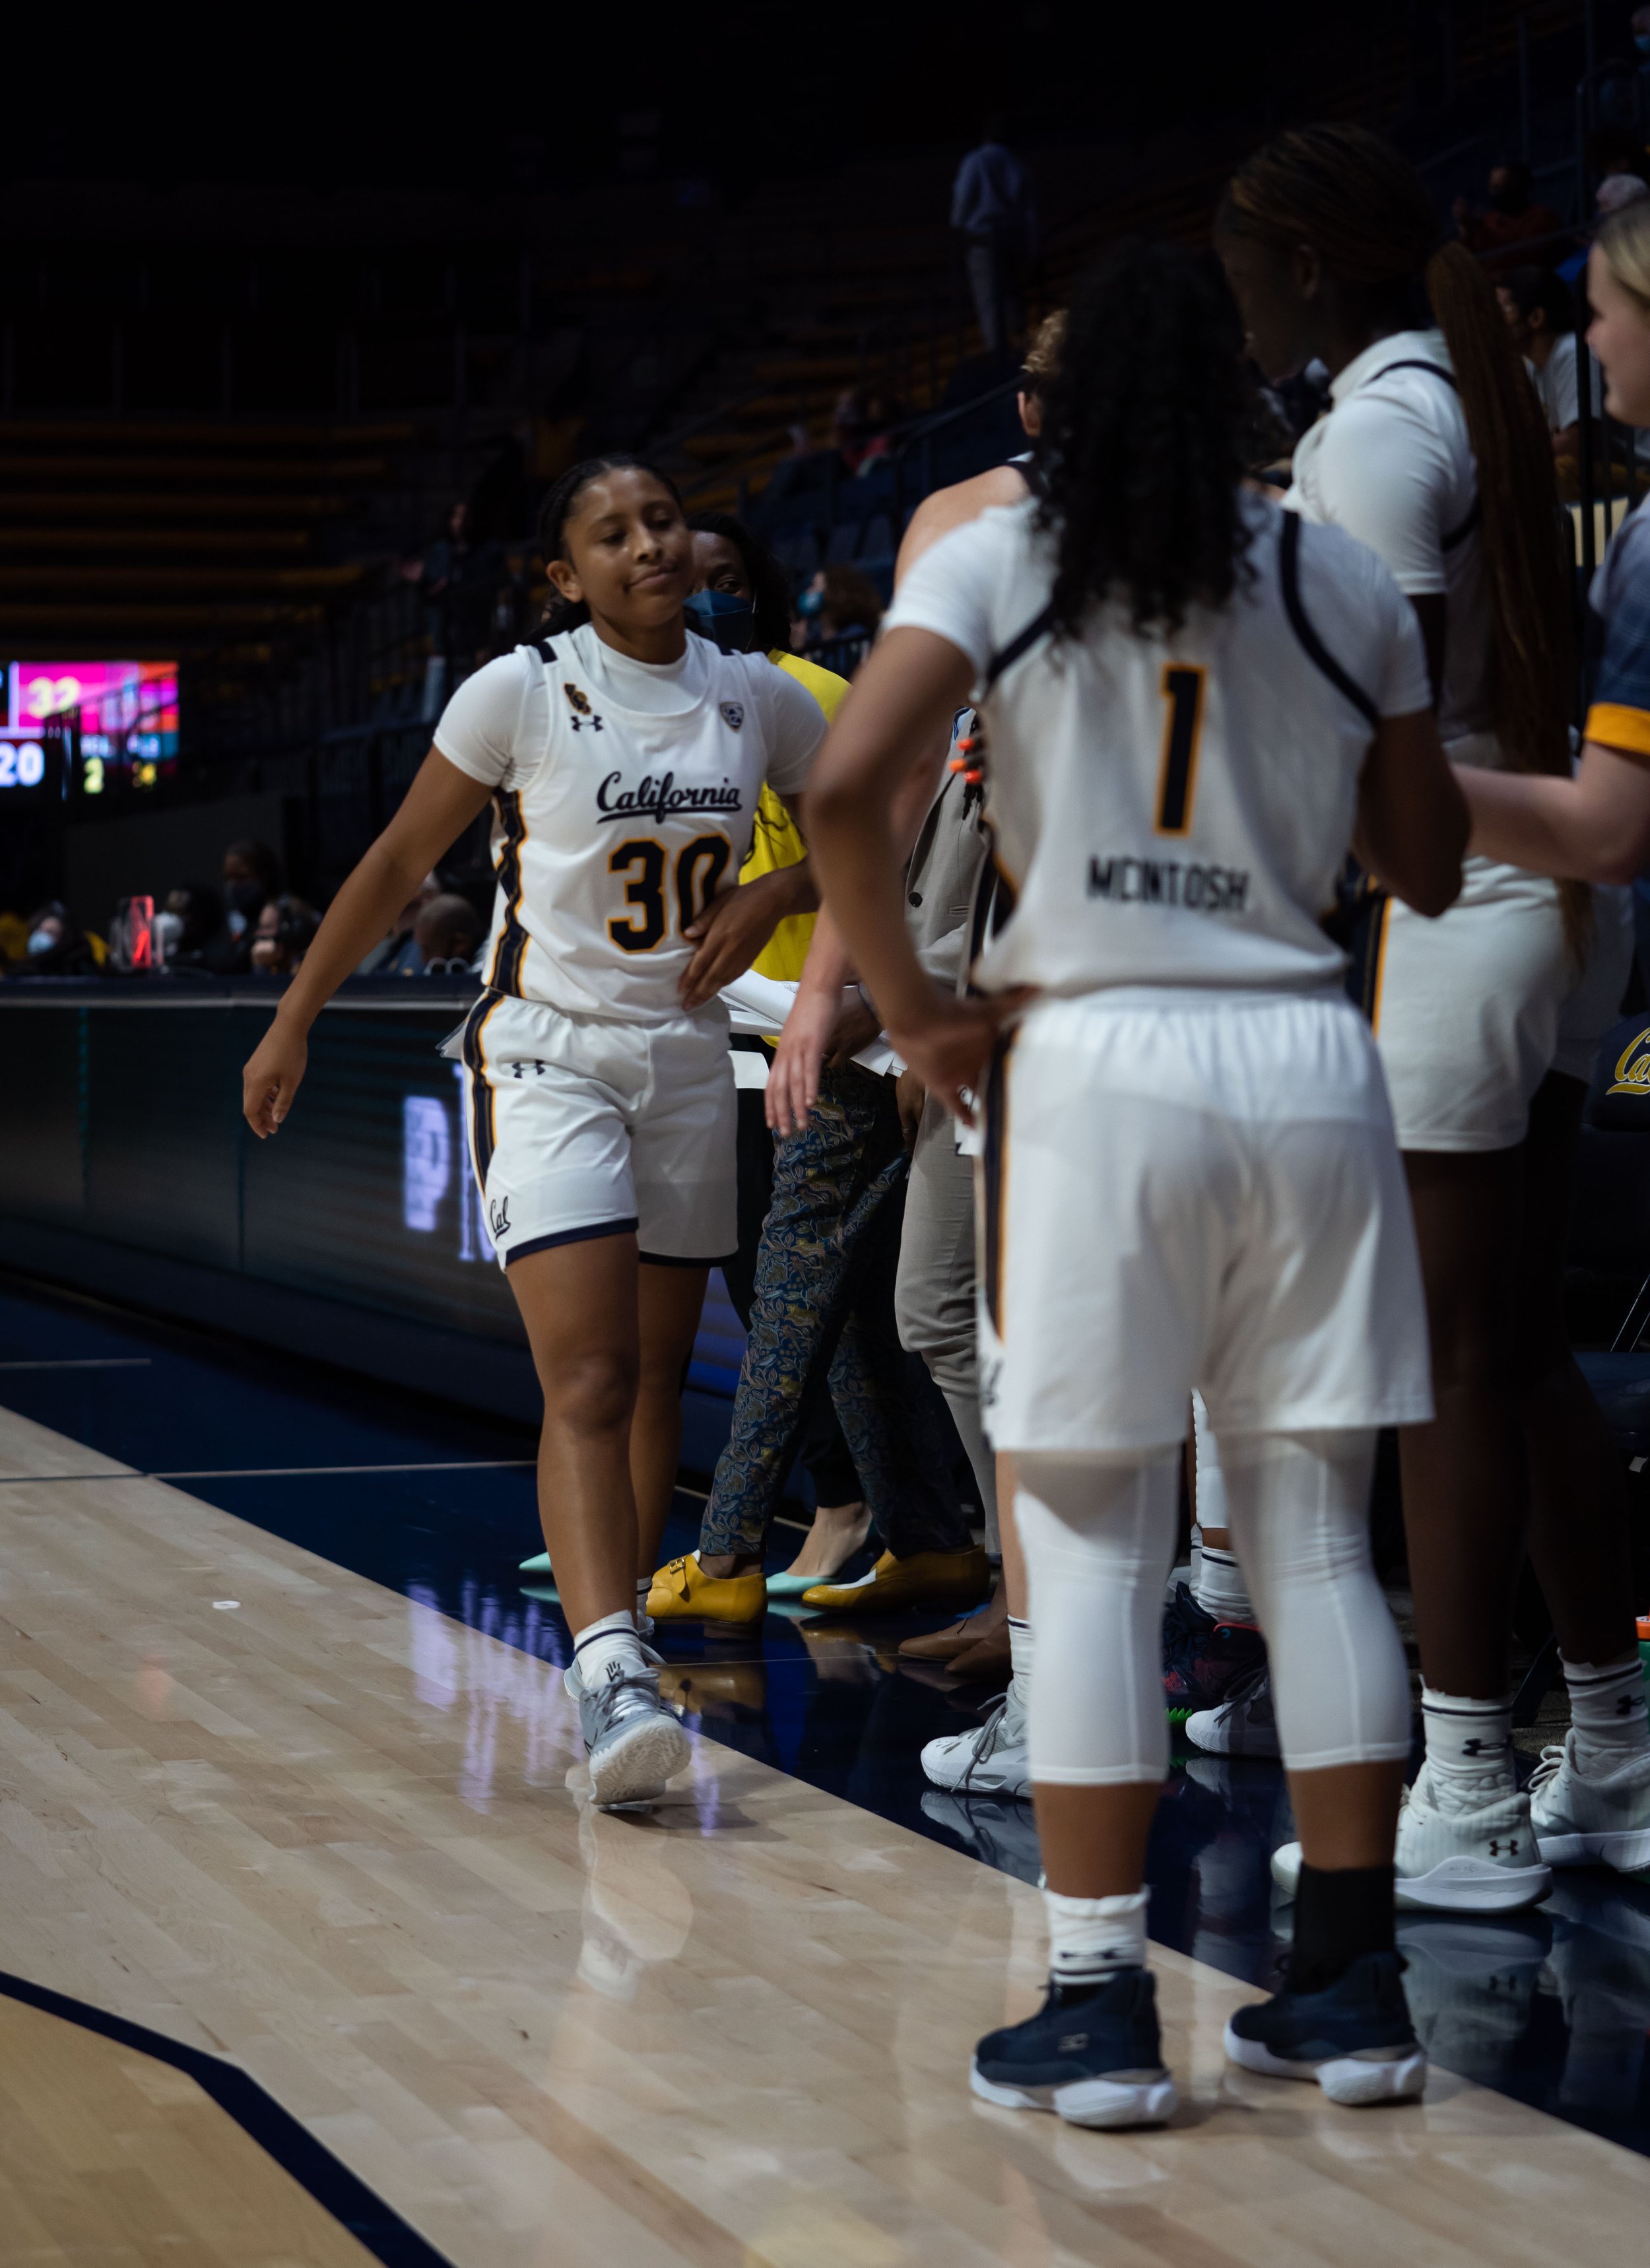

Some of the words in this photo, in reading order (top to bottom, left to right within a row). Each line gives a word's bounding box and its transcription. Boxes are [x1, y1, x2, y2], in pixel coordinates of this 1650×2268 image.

[1156, 664, 1208, 837] 1
[597, 771, 742, 824] California
[609, 832, 731, 954] 30
[1606, 1027, 1650, 1095] Ca
[490, 1196, 511, 1240] Cal
